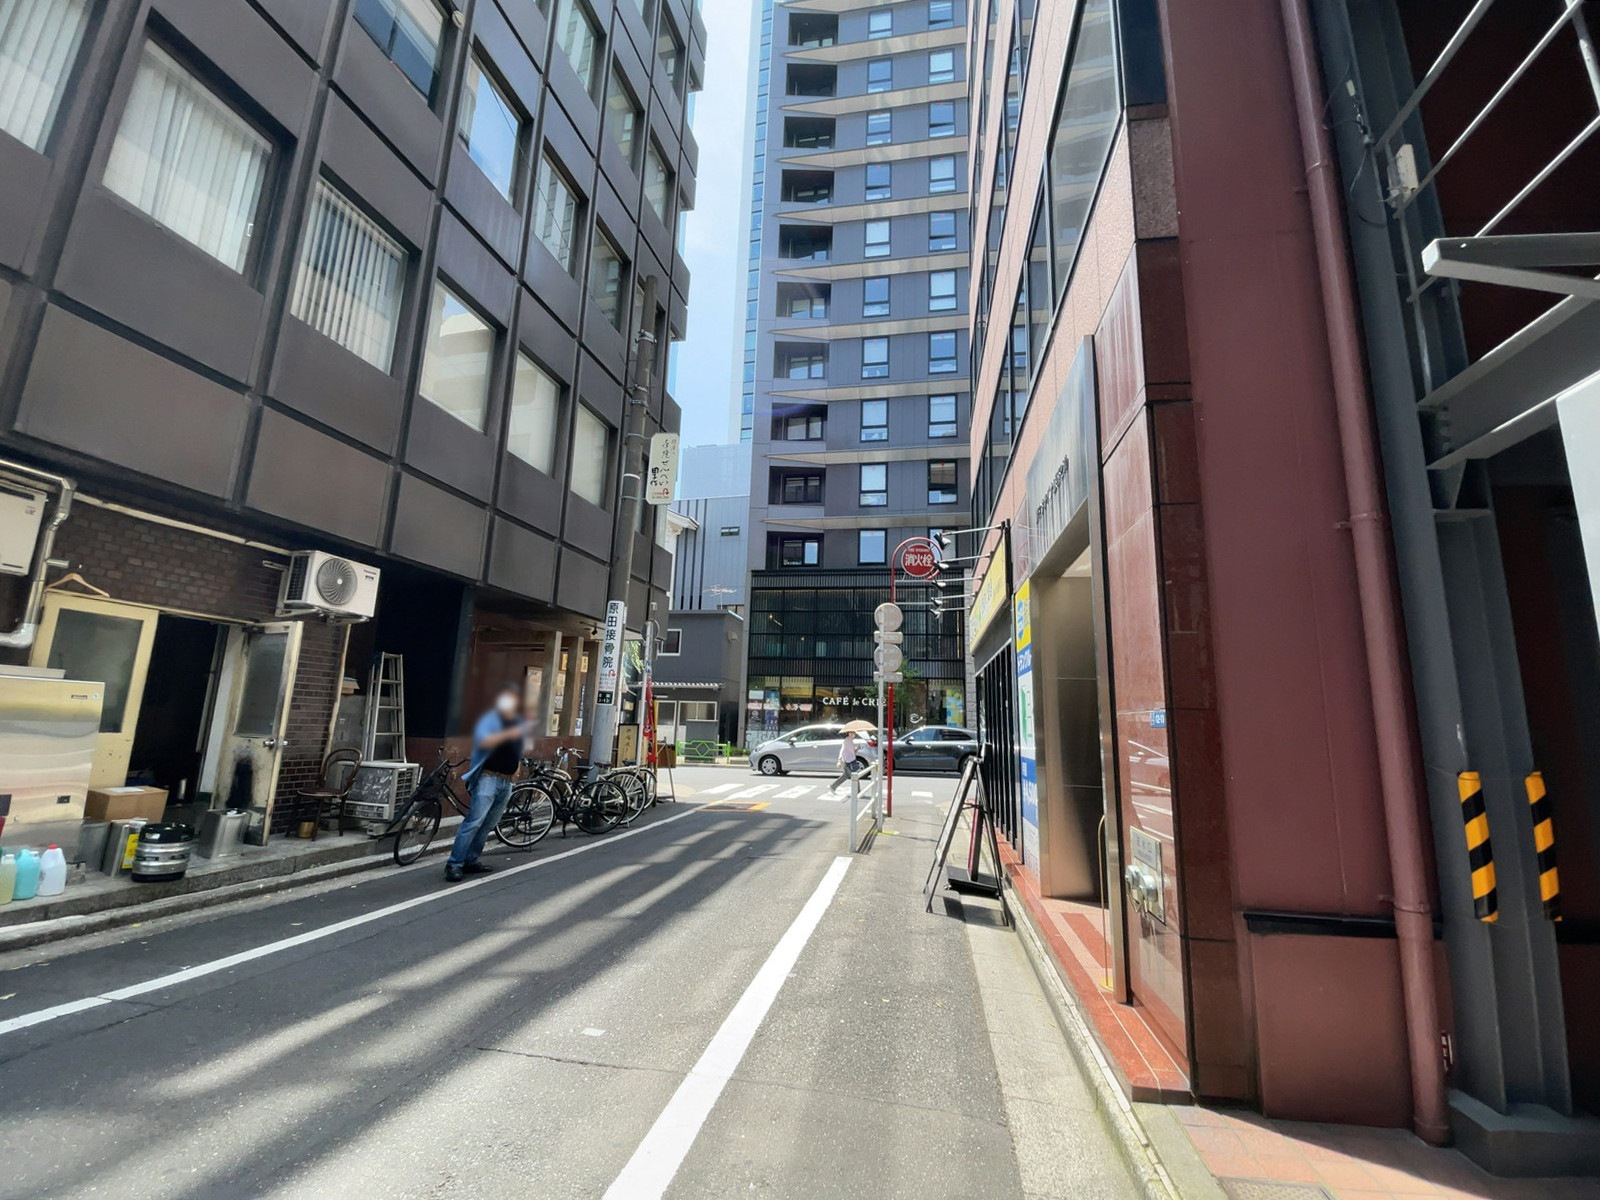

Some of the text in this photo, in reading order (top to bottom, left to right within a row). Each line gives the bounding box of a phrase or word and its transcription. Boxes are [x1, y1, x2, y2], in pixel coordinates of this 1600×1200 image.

[905, 553, 933, 567] 消火栓
[602, 602, 620, 669] 原田接骨院
[822, 695, 849, 706] CAFÉ
